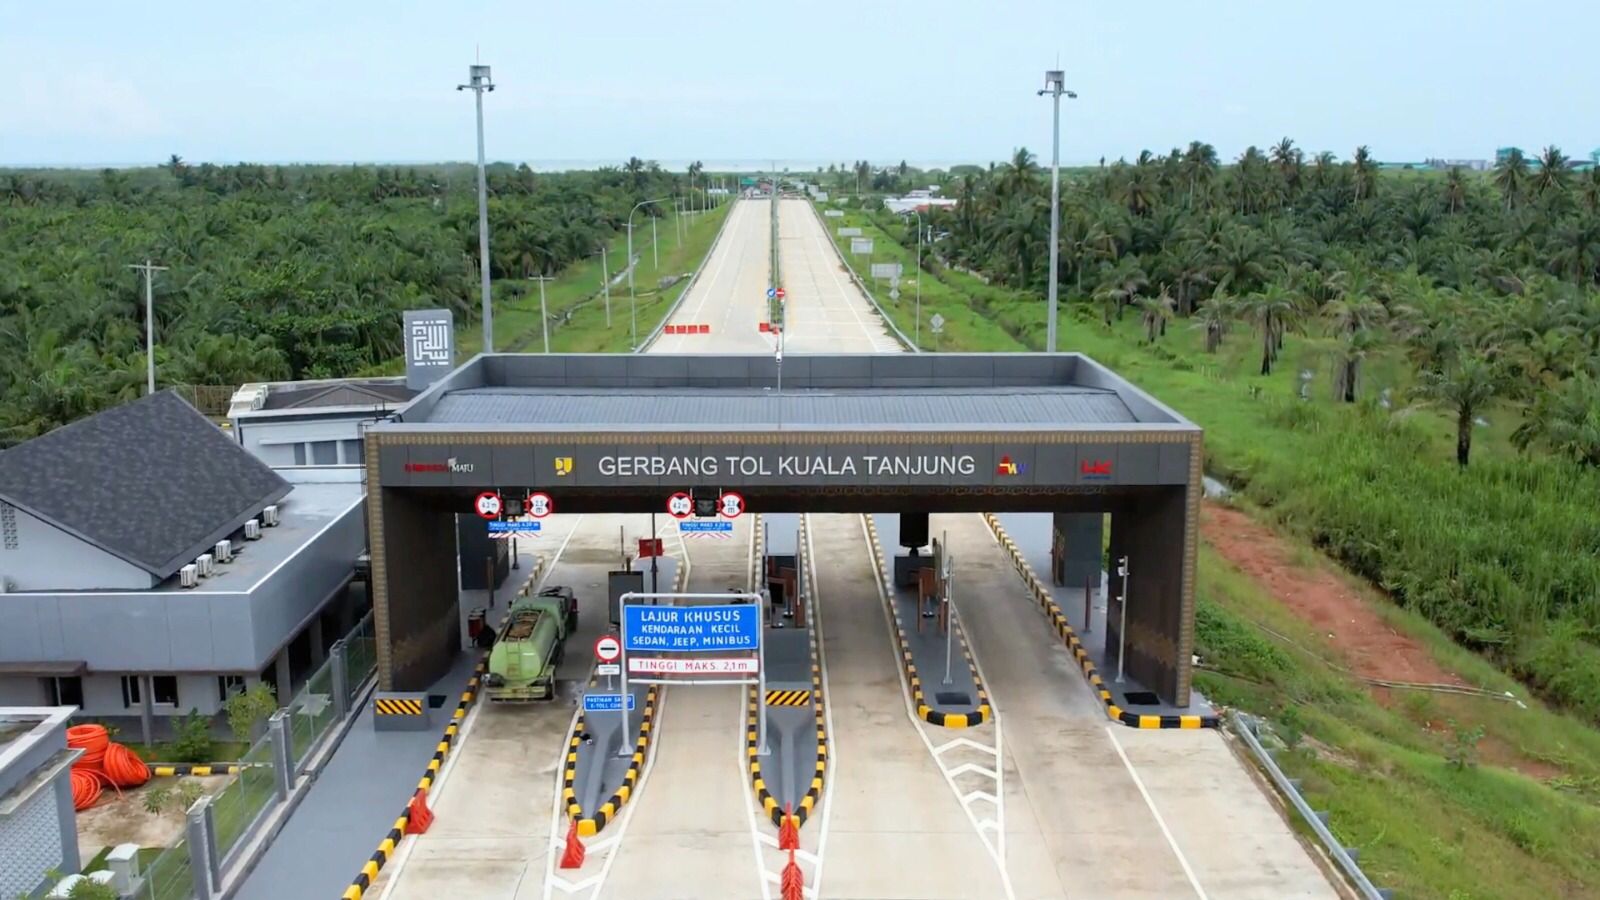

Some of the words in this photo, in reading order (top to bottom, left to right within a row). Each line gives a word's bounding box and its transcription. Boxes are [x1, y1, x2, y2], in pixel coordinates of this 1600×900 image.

[598, 456, 719, 476] GERBANG
[725, 456, 772, 476] TOL
[778, 456, 857, 476] KUALA
[863, 455, 976, 476] TANJUNG
[641, 610, 678, 623] LAJUR
[684, 610, 741, 623] KHUSUS
[641, 625, 703, 635] KENDARAAN
[711, 624, 741, 634] KECIL
[632, 635, 670, 647] SEDAN,
[672, 636, 700, 647] JEEP,
[703, 635, 751, 645] MINIBUS
[638, 660, 677, 670] TINGGI
